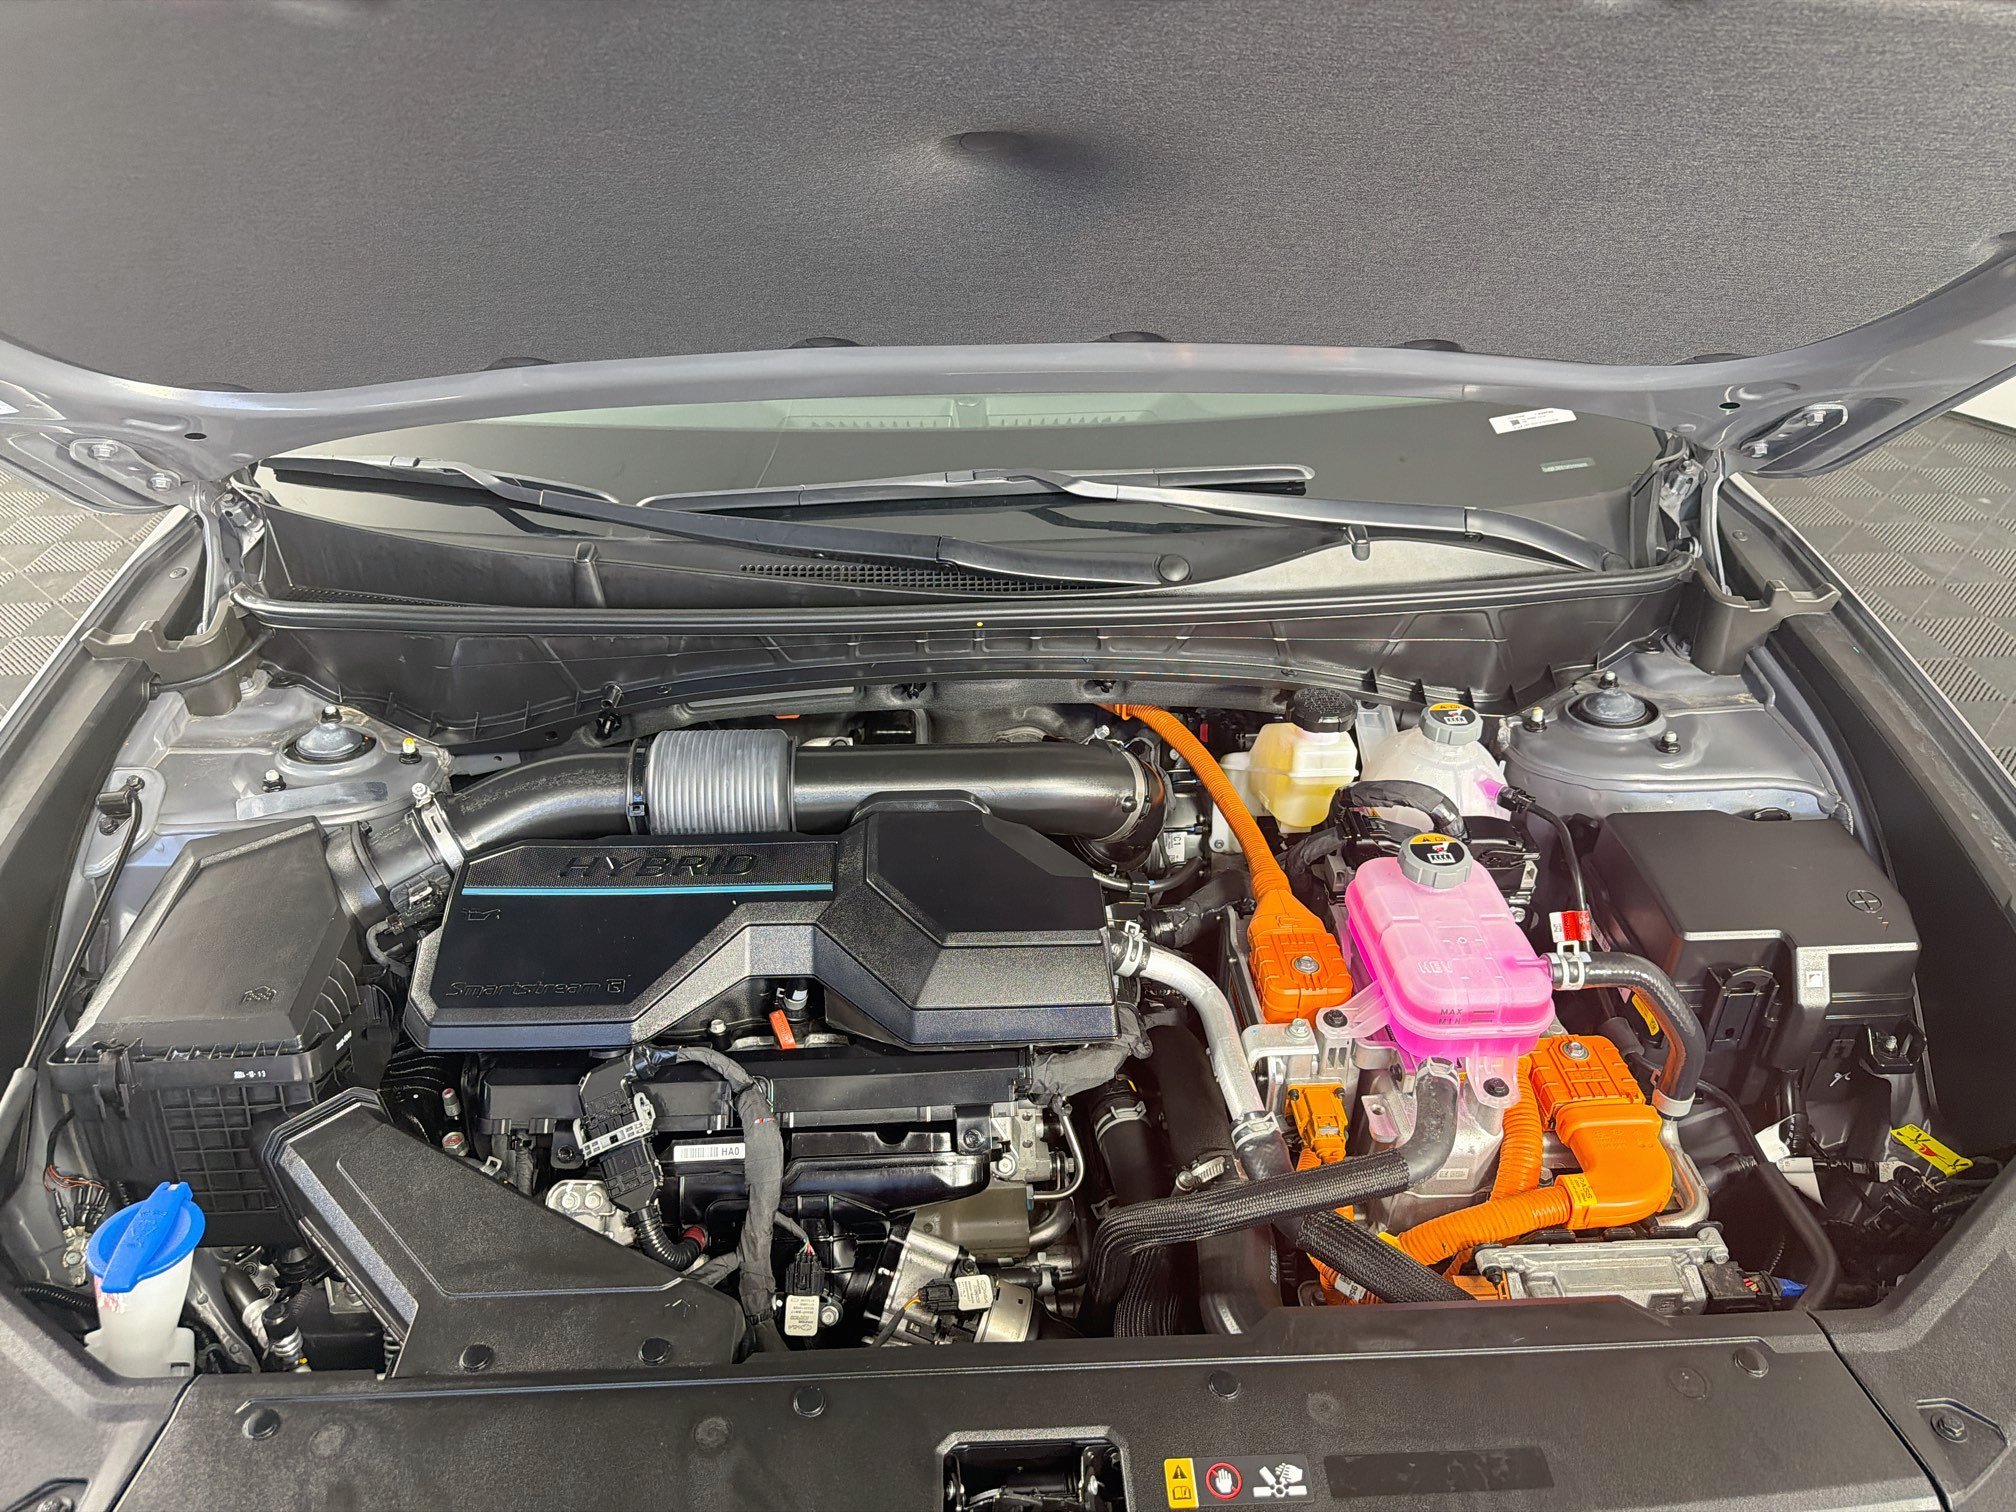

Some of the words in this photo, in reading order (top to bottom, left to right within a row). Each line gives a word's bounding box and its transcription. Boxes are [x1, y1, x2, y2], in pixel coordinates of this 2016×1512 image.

[557, 854, 758, 878] HYBRID
[445, 981, 601, 998] Smartstream
[1440, 1008, 1463, 1016] MAX
[1438, 1017, 1461, 1025] MIN
[1577, 1176, 1593, 1200] PASS
